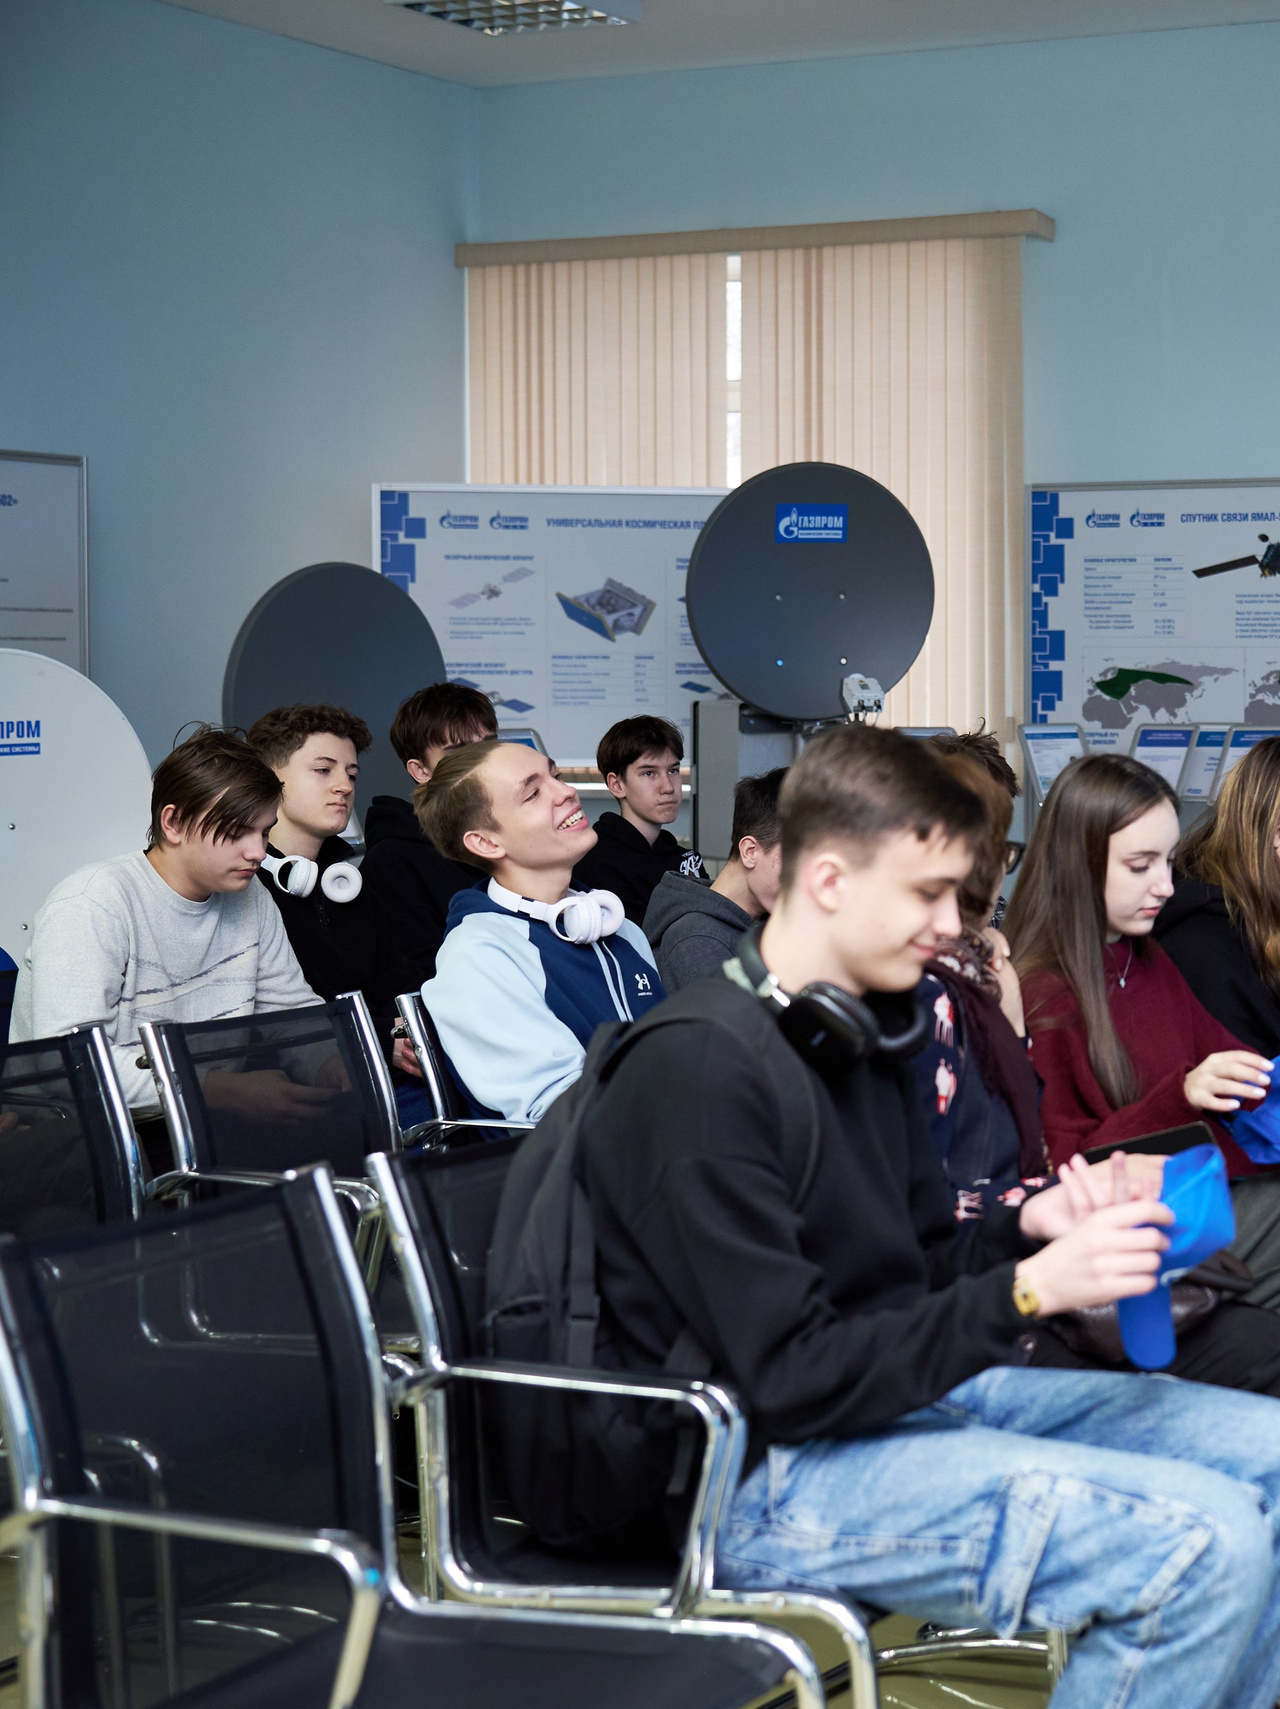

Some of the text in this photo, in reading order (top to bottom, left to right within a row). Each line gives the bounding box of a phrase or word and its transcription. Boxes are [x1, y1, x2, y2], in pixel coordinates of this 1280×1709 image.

[546, 517, 624, 528] УНИВЕРСАЛЬНАЯ
[625, 519, 691, 530] КОСМИЧЕСКАЯ
[798, 516, 843, 528] ГАЗПРОМ
[1180, 513, 1219, 523] СПУТНИК
[1221, 513, 1249, 522] СВЯЗИ
